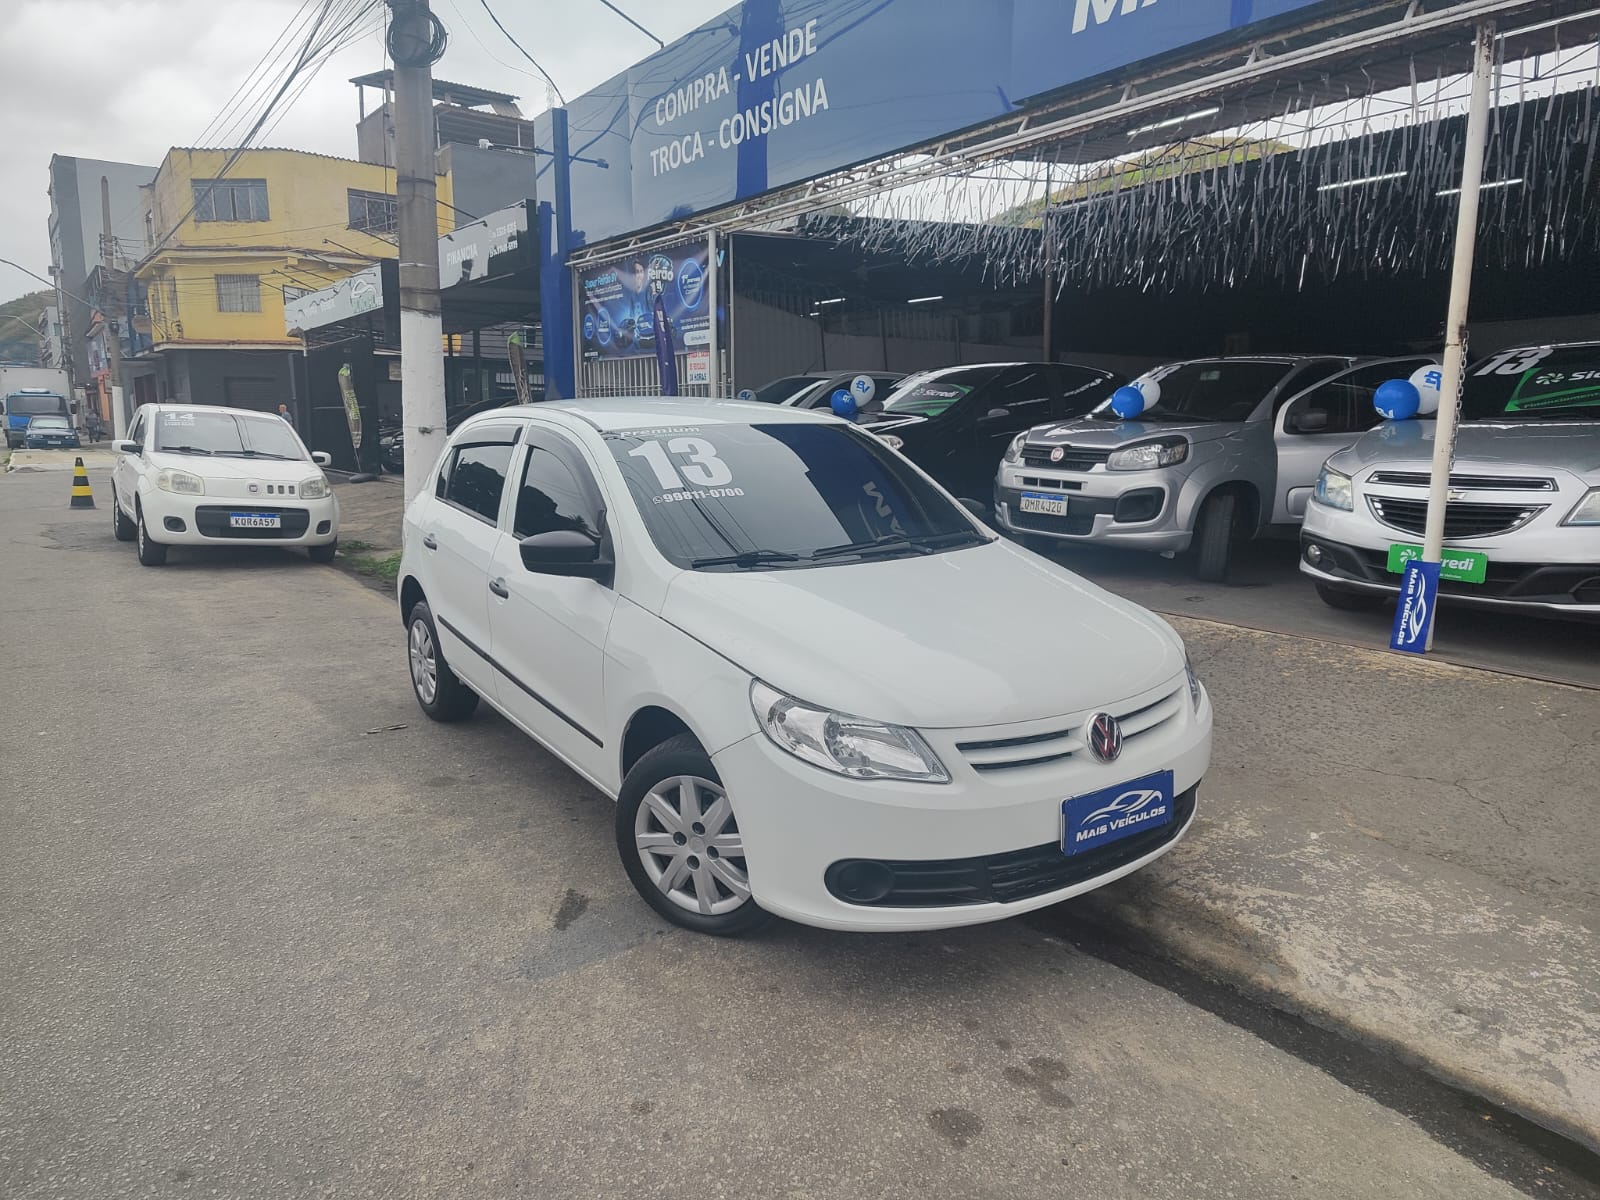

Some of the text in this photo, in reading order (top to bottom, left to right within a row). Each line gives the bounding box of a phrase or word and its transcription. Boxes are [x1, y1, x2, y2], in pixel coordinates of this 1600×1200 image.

[655, 66, 730, 126] COMPRA
[745, 19, 817, 82] VENDE
[650, 131, 704, 177] TROCA
[719, 78, 829, 150] CONSIGNA
[1474, 349, 1554, 376] 13
[628, 437, 733, 490] 13
[662, 487, 745, 503] 99811-0700
[1407, 568, 1419, 595] MAIS
[1075, 825, 1108, 842] MAIS
